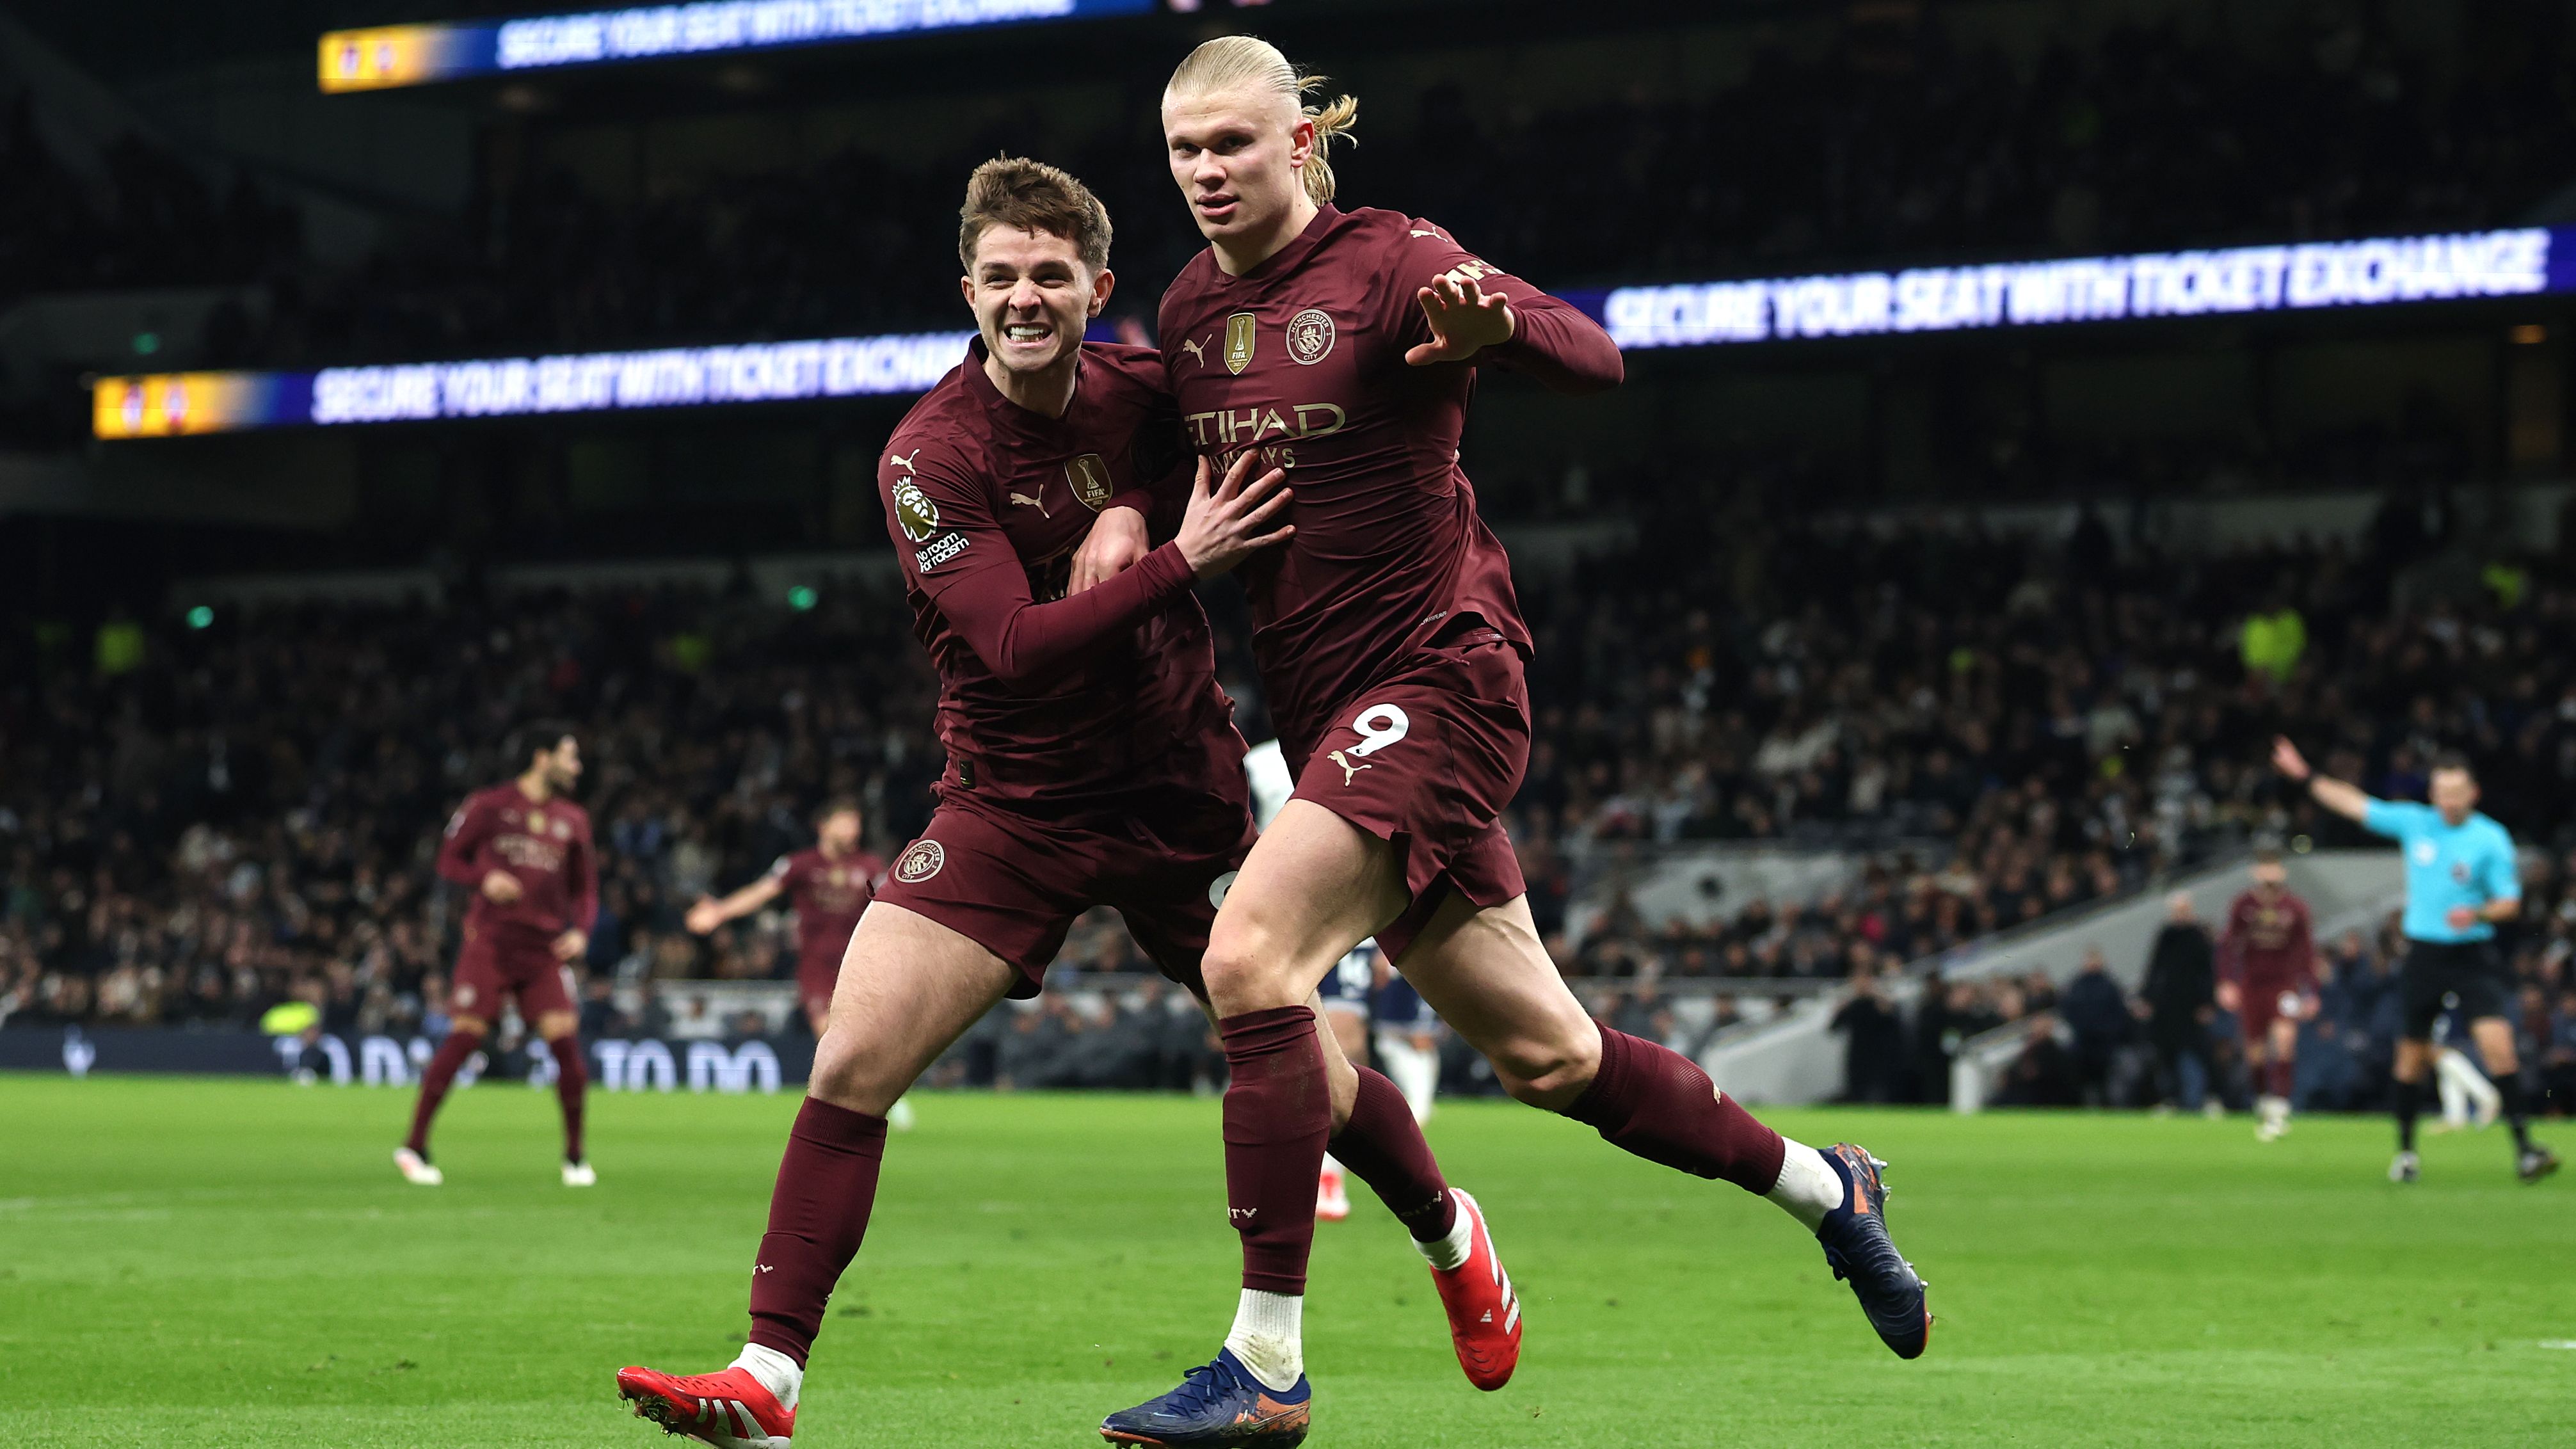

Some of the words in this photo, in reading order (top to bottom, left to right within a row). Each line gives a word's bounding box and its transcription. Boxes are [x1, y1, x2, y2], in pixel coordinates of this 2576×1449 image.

[497, 17, 603, 66] SECURE
[608, 9, 677, 54] YOUR
[679, 1, 743, 49] SEAT
[1604, 282, 1766, 347] SECURE
[1774, 275, 1892, 335] YOUR
[1894, 266, 2003, 330] SEAT
[2008, 260, 2125, 322] WITH
[2131, 248, 2285, 314] TICKET
[2289, 230, 2550, 305] EXCHANGE
[1291, 314, 1329, 333] MANCHESTER
[312, 365, 436, 422] SECURE
[444, 361, 532, 414] YOUR
[537, 355, 612, 410] SEAT
[616, 351, 703, 404] WITH
[706, 342, 820, 399] TICKET
[1184, 403, 1346, 446] TIHAD
[1086, 488, 1105, 498] FIFA
[915, 550, 928, 564] No
[927, 532, 959, 556] room
[920, 559, 932, 573] for
[931, 538, 970, 566] racism
[1345, 703, 1409, 757] 9
[909, 844, 940, 862] MANCHESTER
